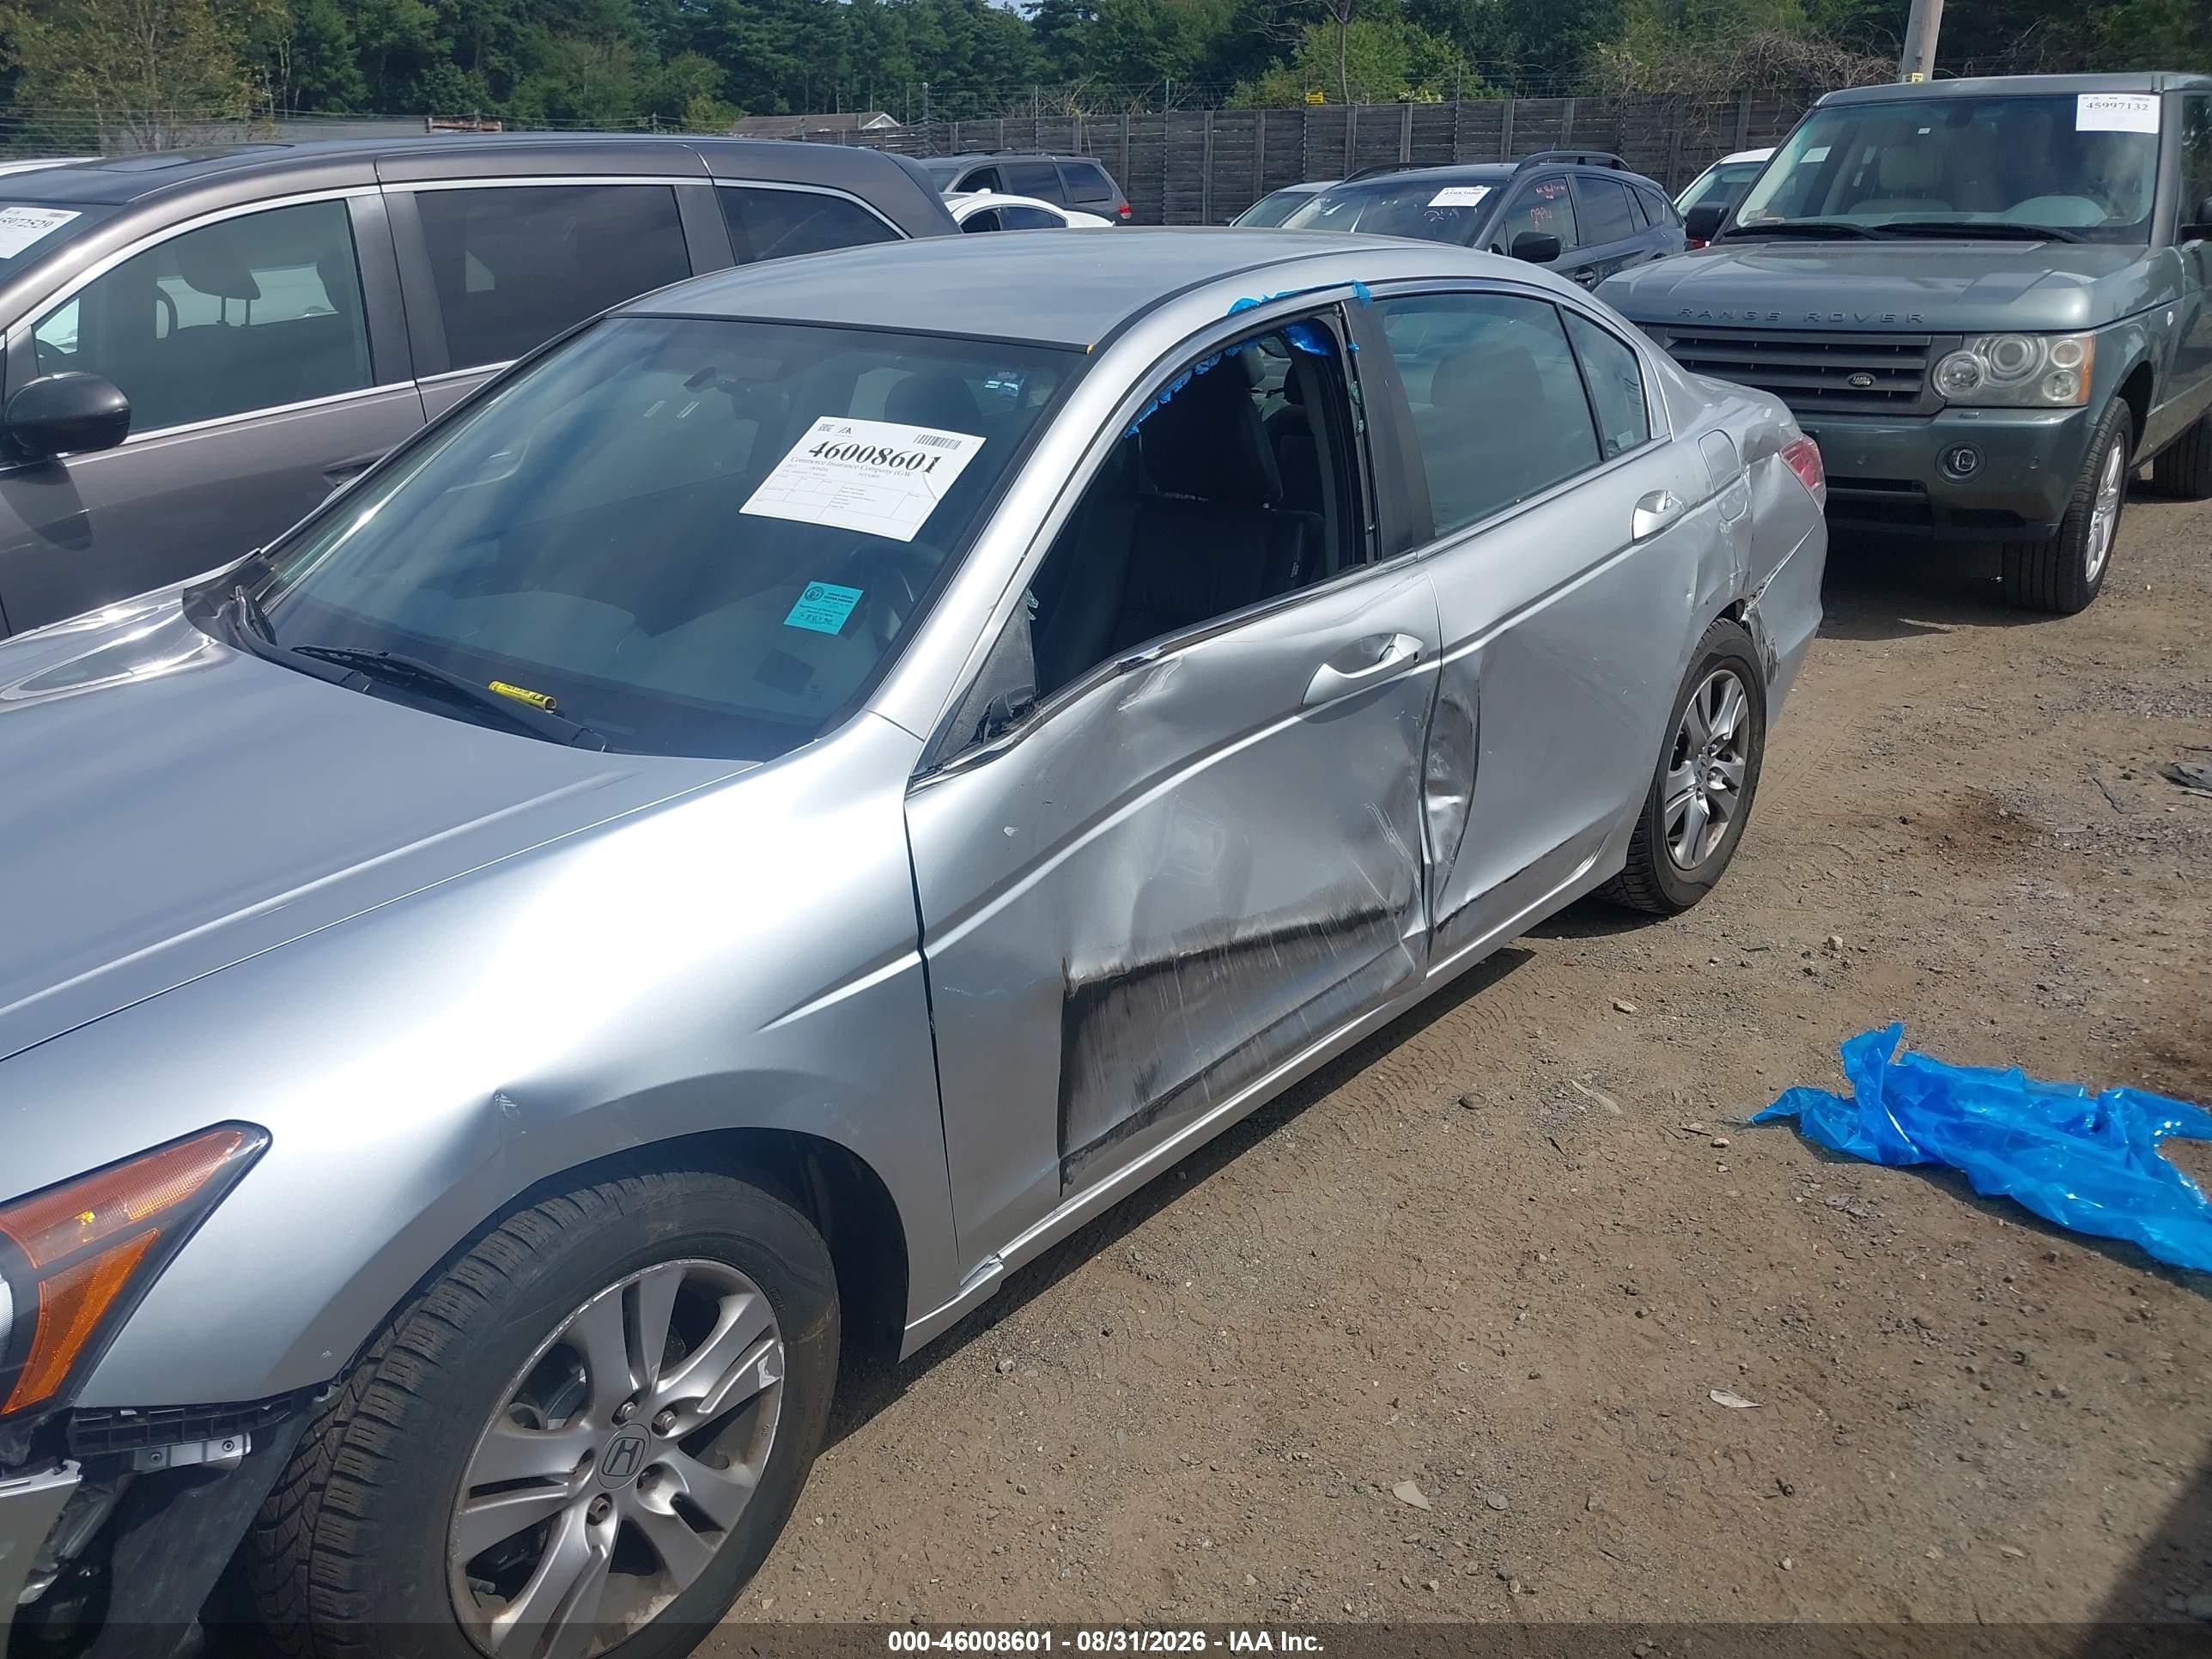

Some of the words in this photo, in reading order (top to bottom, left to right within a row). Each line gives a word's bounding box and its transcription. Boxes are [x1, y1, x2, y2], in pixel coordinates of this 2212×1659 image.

[2086, 101, 2149, 111] 45997132
[1678, 307, 1782, 322] RANGE
[1803, 311, 1924, 324] ROVER
[808, 440, 943, 474] 46008601
[826, 459, 860, 470] Insurance
[860, 464, 893, 476] Company
